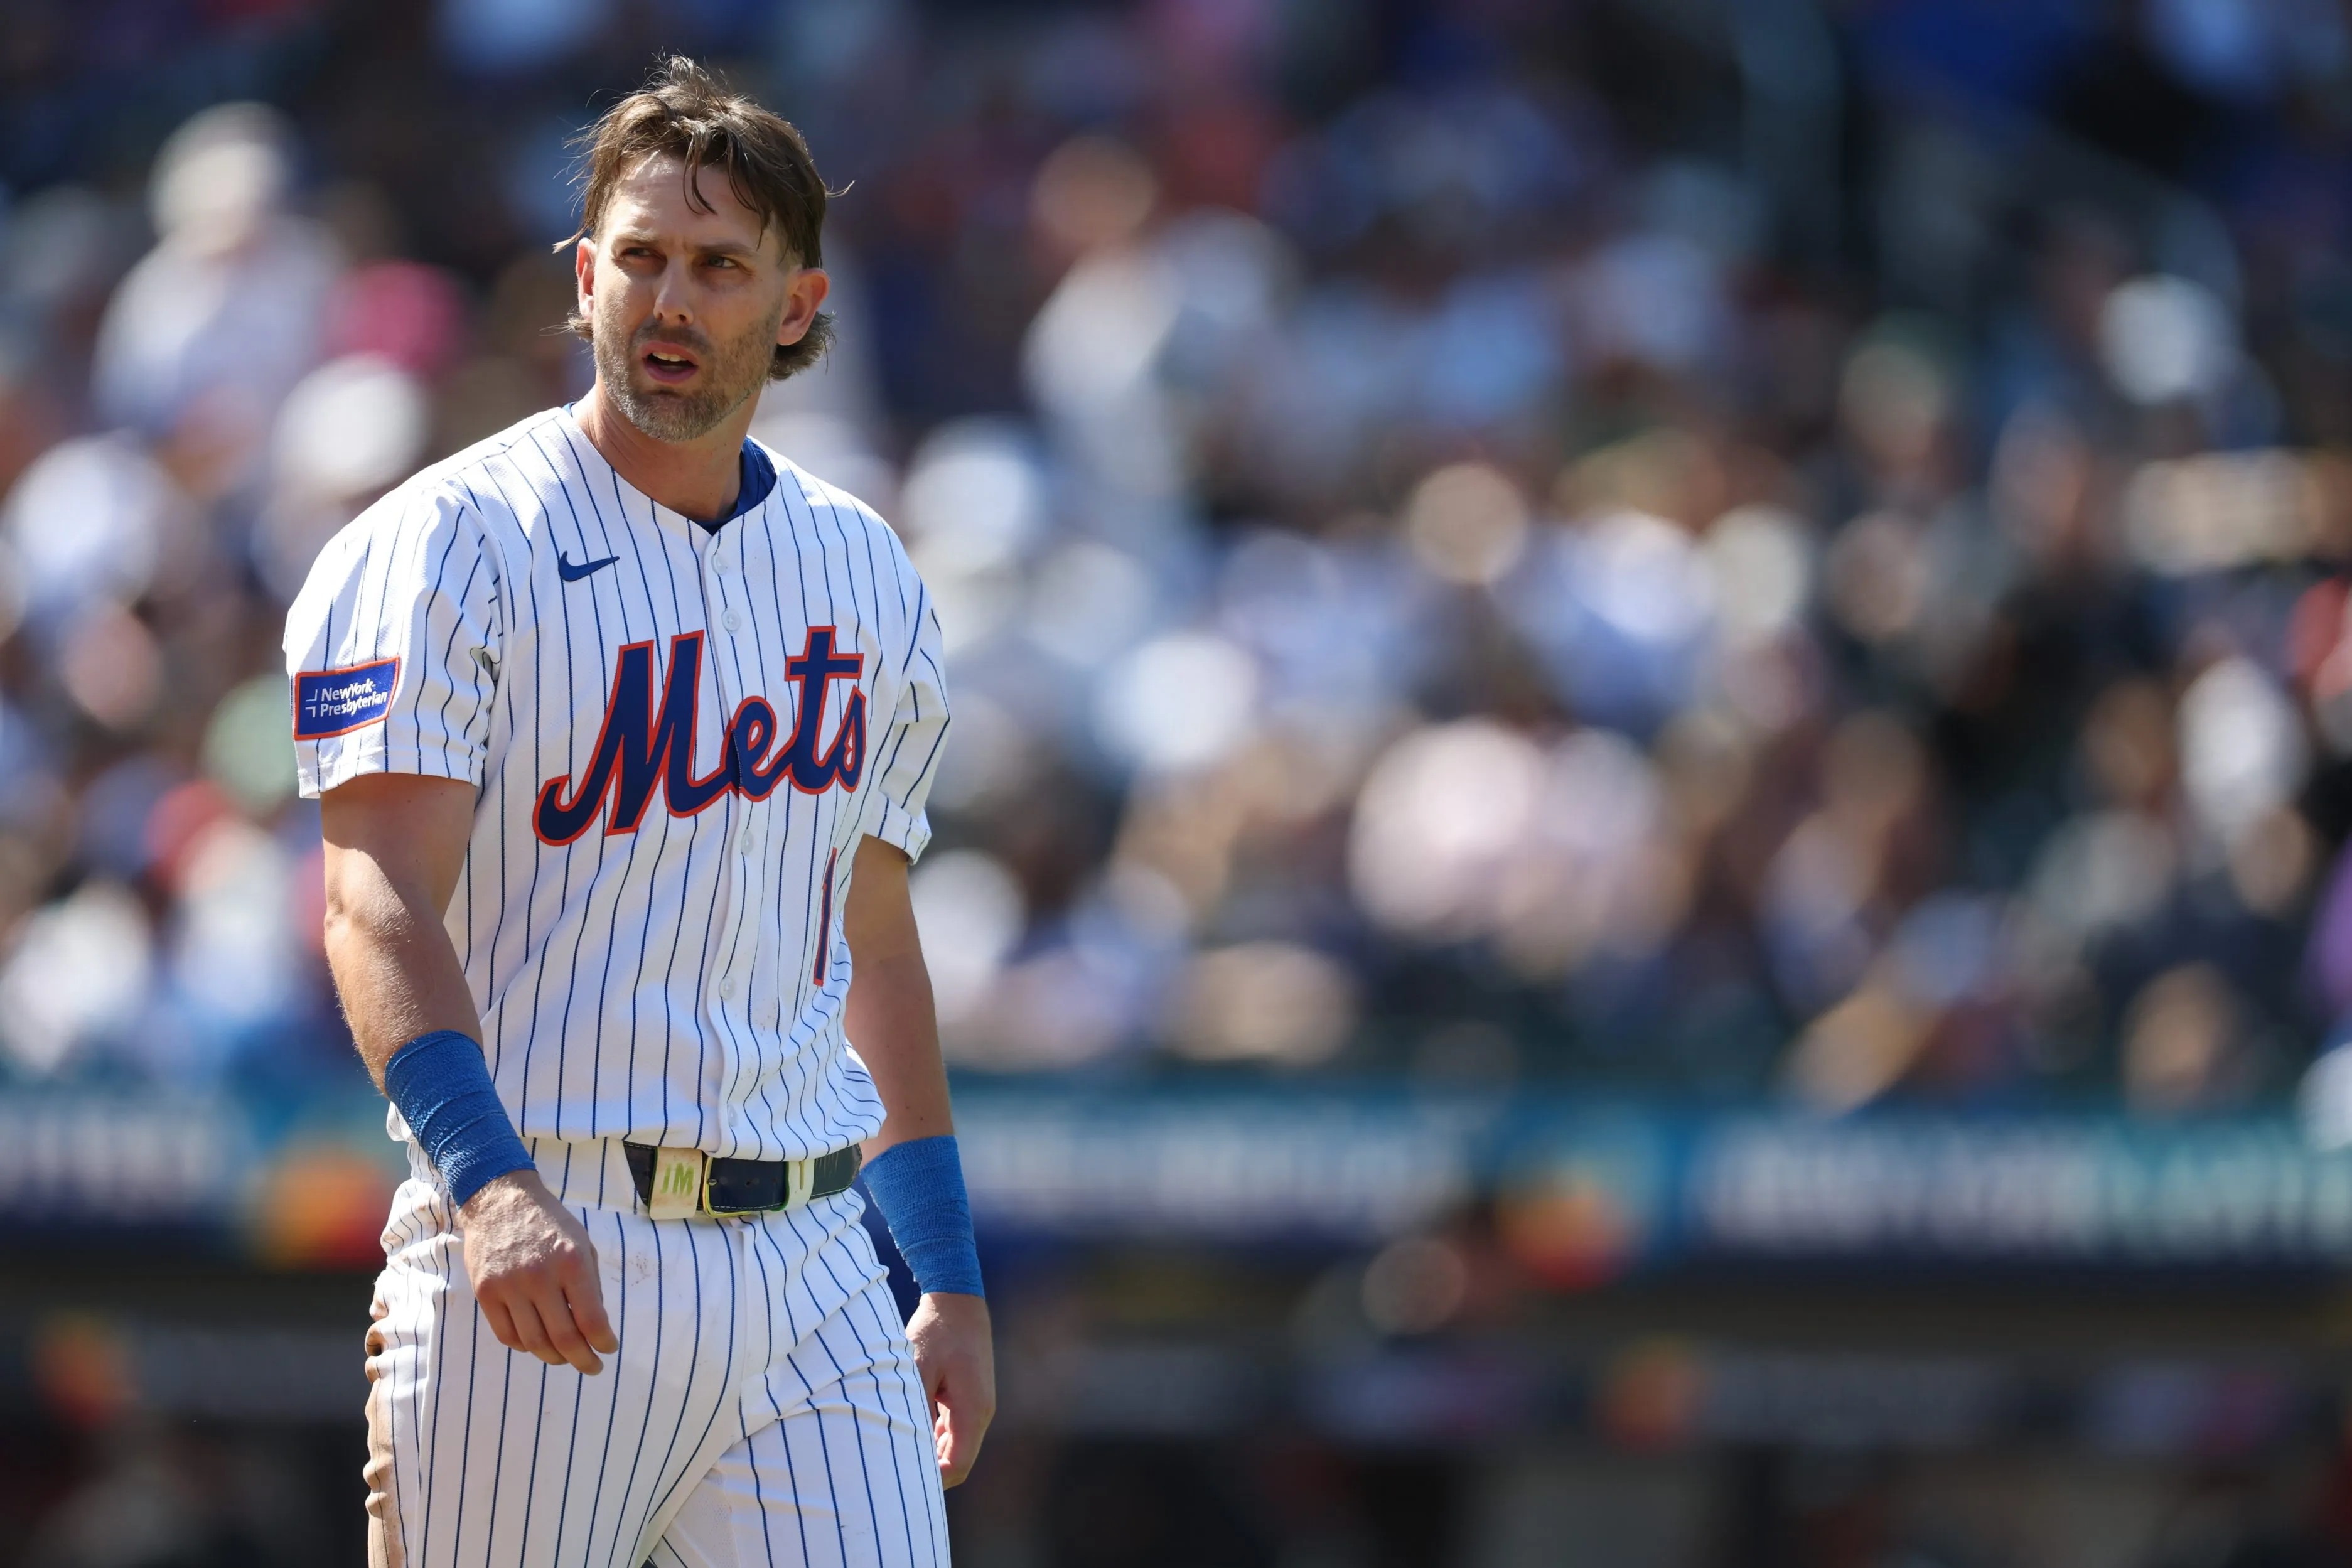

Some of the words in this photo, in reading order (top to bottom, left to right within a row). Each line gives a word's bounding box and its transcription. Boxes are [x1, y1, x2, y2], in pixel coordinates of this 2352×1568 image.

[320, 690, 388, 717] Presbyterian
[532, 625, 866, 846] Mets
[813, 847, 837, 987] 1
